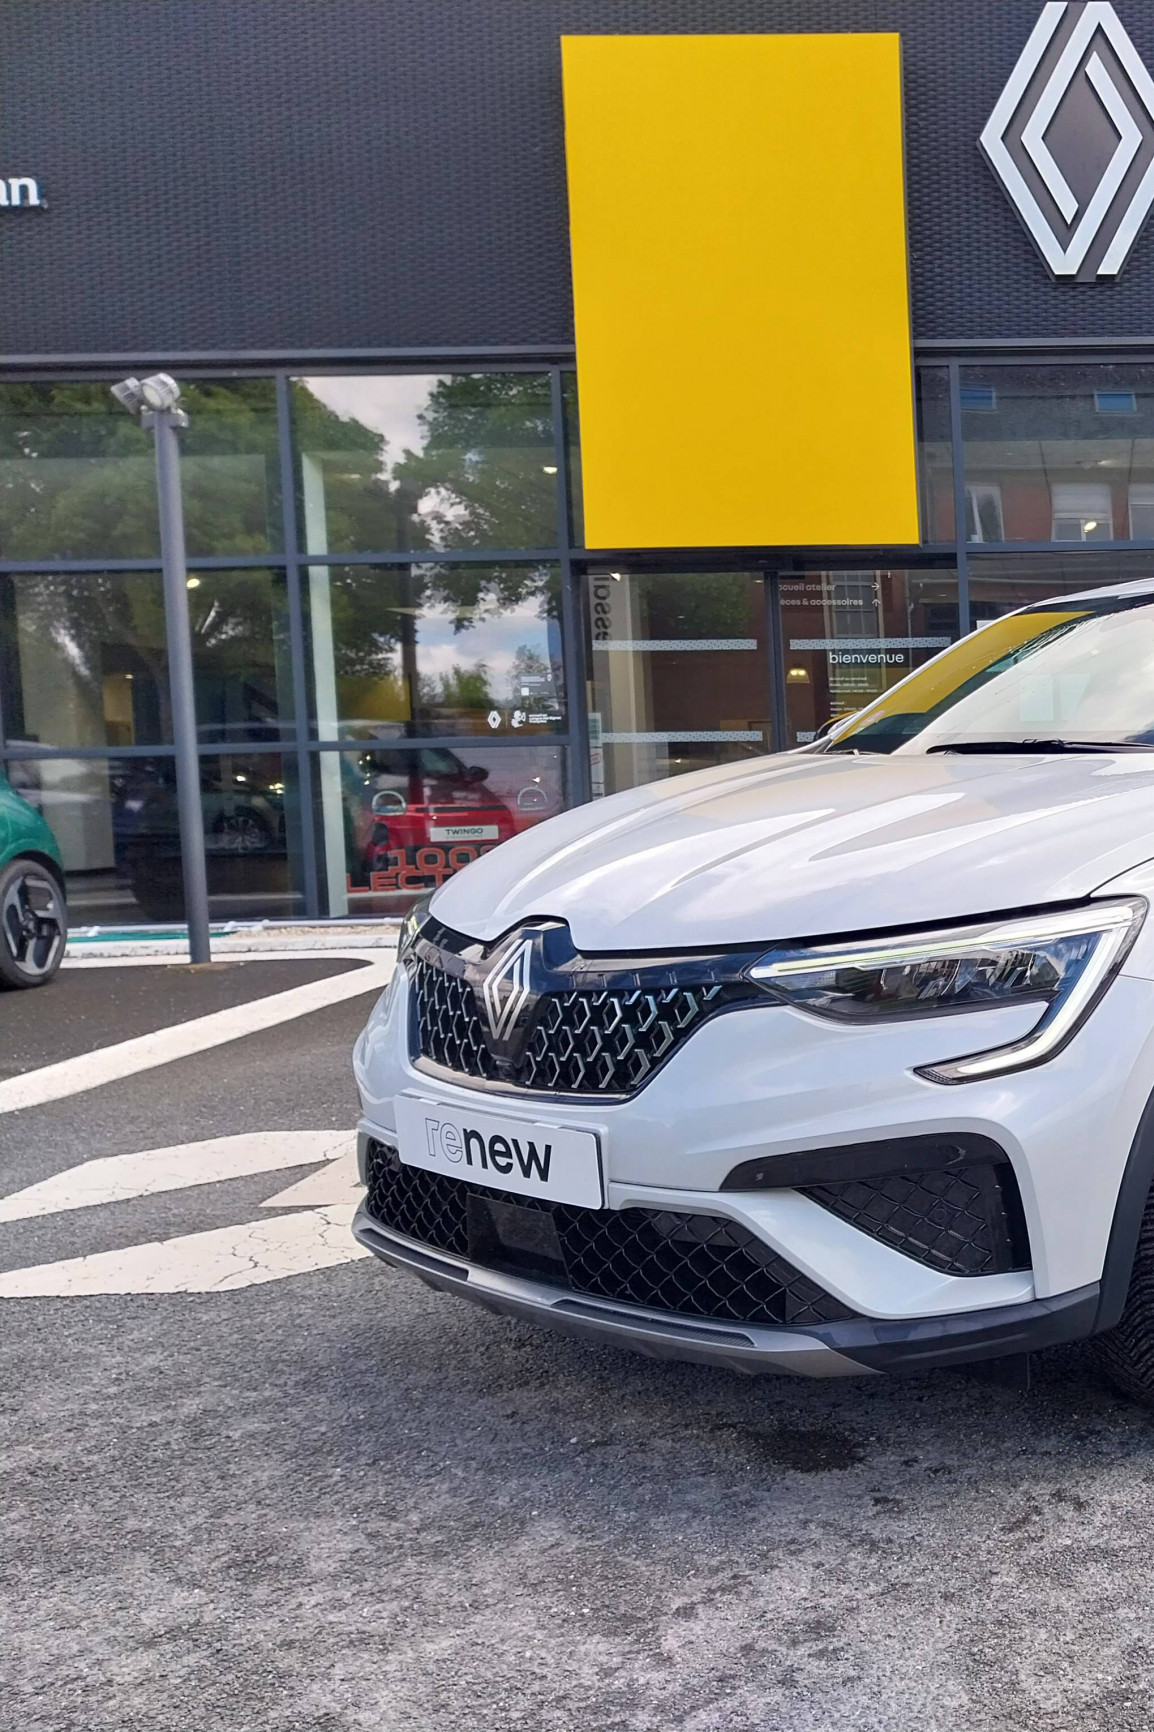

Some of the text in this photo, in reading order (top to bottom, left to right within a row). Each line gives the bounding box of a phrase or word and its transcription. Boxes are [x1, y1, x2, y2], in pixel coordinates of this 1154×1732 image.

[0, 177, 41, 206] n
[802, 598, 809, 606] &
[809, 597, 863, 606] accessoires
[829, 651, 904, 664] bienvenue
[444, 827, 484, 836] TWINGO
[387, 845, 497, 874] 100
[424, 1117, 553, 1183] renew
